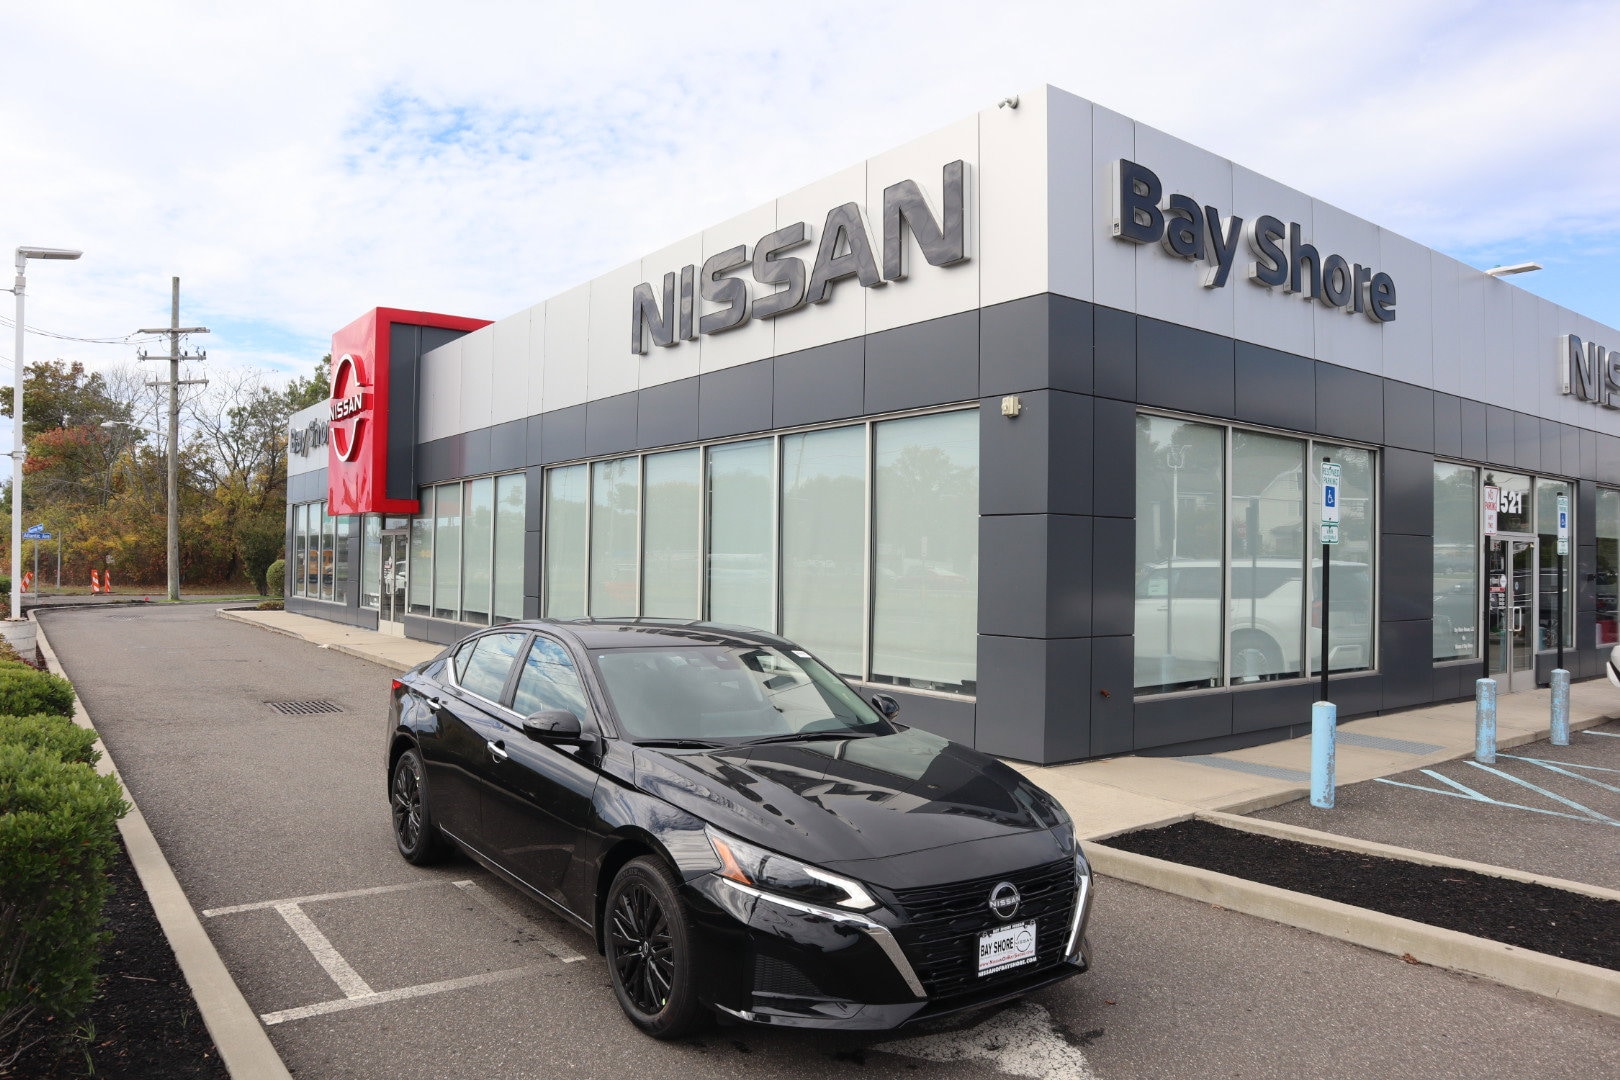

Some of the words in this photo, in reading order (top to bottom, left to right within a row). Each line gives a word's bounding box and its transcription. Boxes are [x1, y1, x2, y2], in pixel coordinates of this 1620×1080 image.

[1113, 158, 1243, 289] Bay
[1248, 214, 1397, 323] Shore
[632, 159, 970, 355] NISSAN
[330, 393, 362, 421] NISSAN
[290, 428, 309, 457] Bay
[989, 895, 1021, 908] NISSAN
[980, 943, 992, 957] BAY
[993, 937, 1014, 954] SHORE
